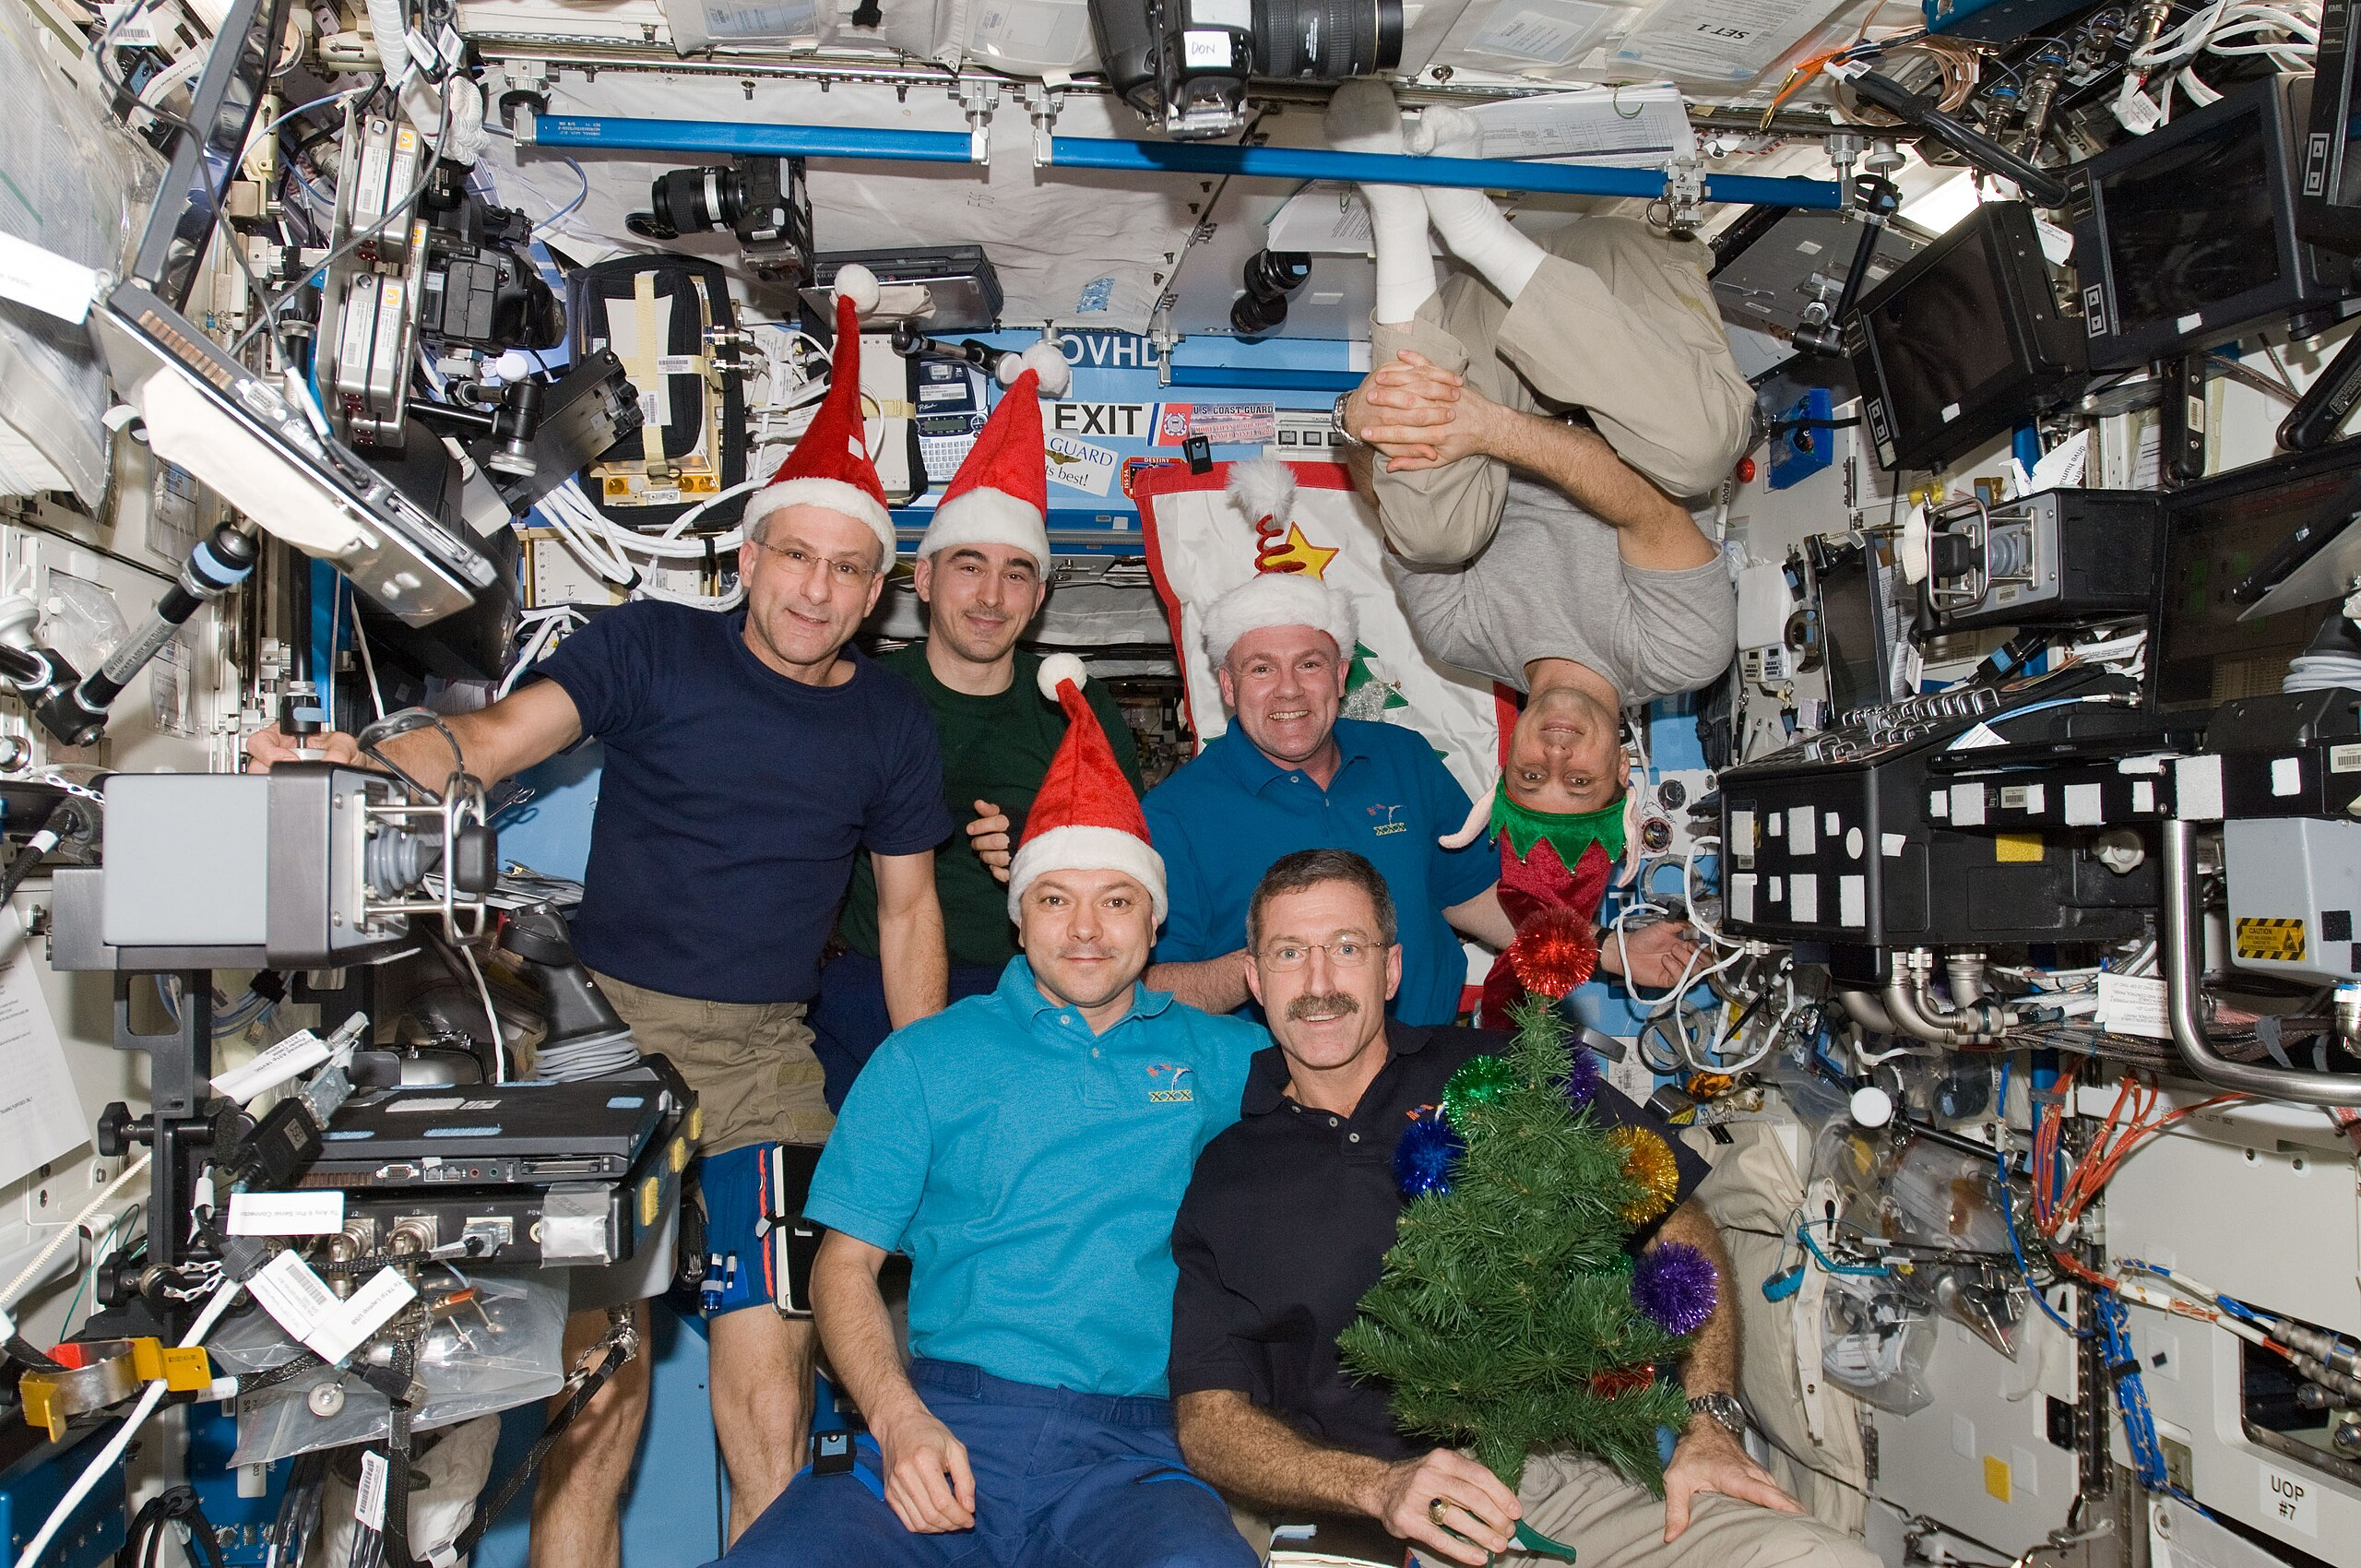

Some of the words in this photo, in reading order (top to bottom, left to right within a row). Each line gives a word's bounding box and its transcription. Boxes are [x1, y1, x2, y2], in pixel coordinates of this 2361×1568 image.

[1710, 28, 1750, 39] SET
[1192, 42, 1215, 55] DON
[1060, 335, 1160, 367] OVHD
[1213, 406, 1241, 414] COAST
[1244, 406, 1274, 414] GUARD
[1055, 404, 1143, 435] EXIT
[1050, 437, 1113, 467] GUARD
[2070, 445, 2085, 462] drive
[1058, 463, 1089, 487] best!
[2058, 463, 2076, 485] huma
[113, 659, 134, 681] BRACKET
[2248, 927, 2273, 935] CAUTION
[1148, 1089, 1193, 1102] XXX
[2205, 1113, 2219, 1123] LEFT
[362, 1297, 382, 1314] Laptop
[350, 1313, 364, 1325] USB
[2271, 1474, 2305, 1502] UOP
[2278, 1500, 2296, 1521] #7
